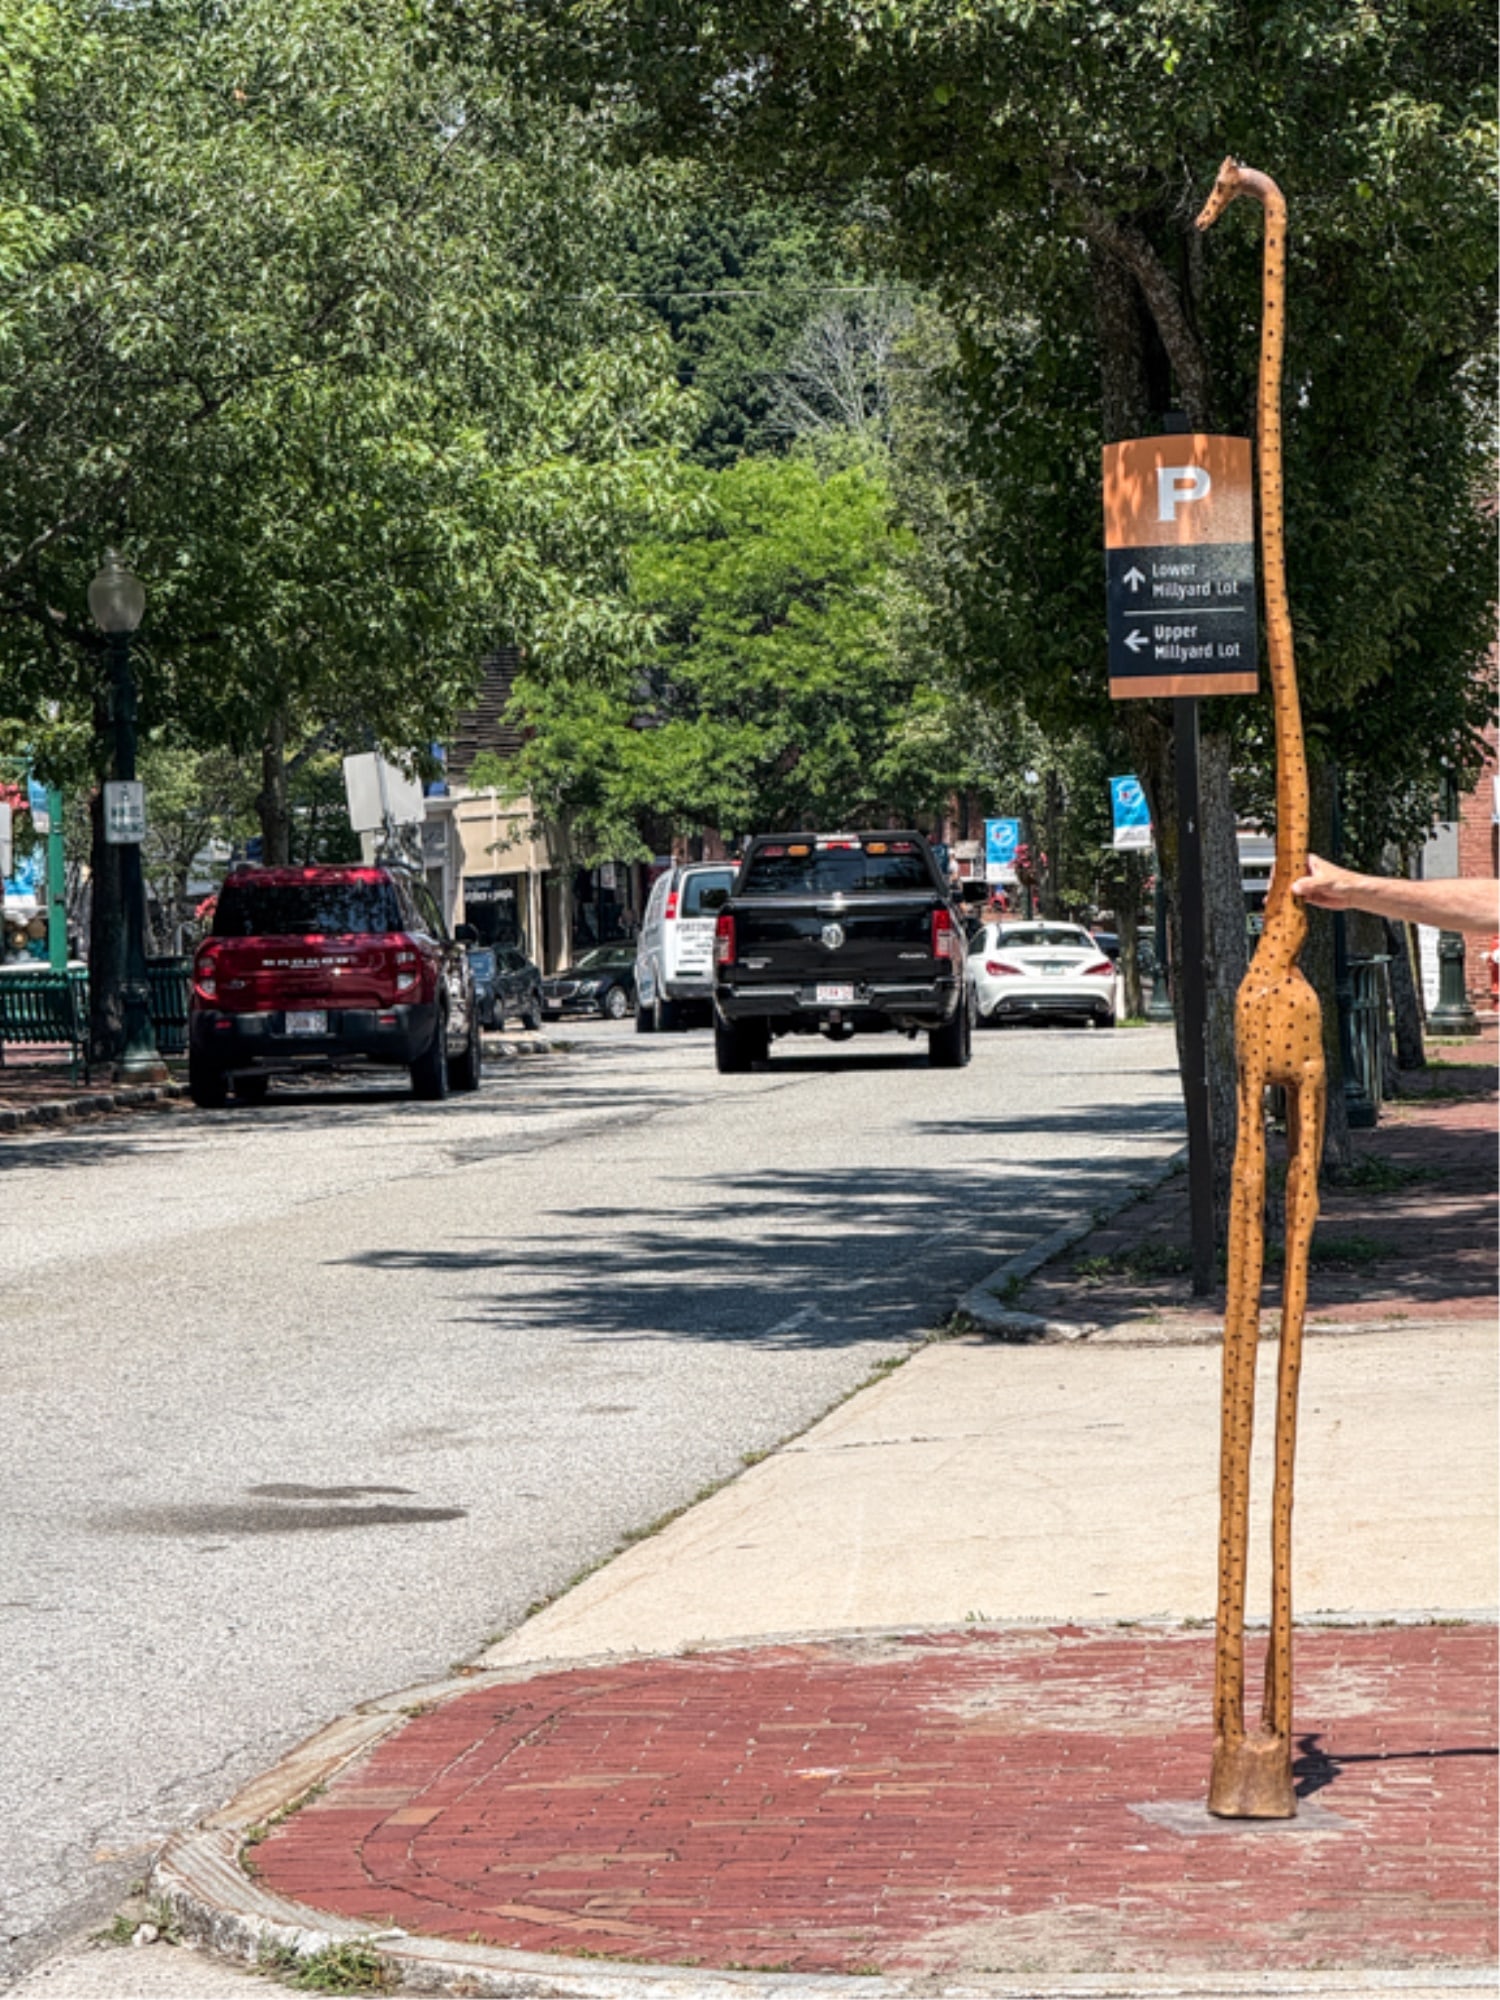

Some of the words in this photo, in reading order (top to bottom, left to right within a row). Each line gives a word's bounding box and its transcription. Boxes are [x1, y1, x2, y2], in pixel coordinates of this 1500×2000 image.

[1156, 465, 1211, 521] P
[1152, 563, 1197, 578] Lower
[1152, 582, 1211, 601] Millyard
[1217, 580, 1238, 596] Lot
[1154, 625, 1198, 642] Upper
[1154, 643, 1213, 663] Millyard
[1218, 642, 1240, 657] Lot
